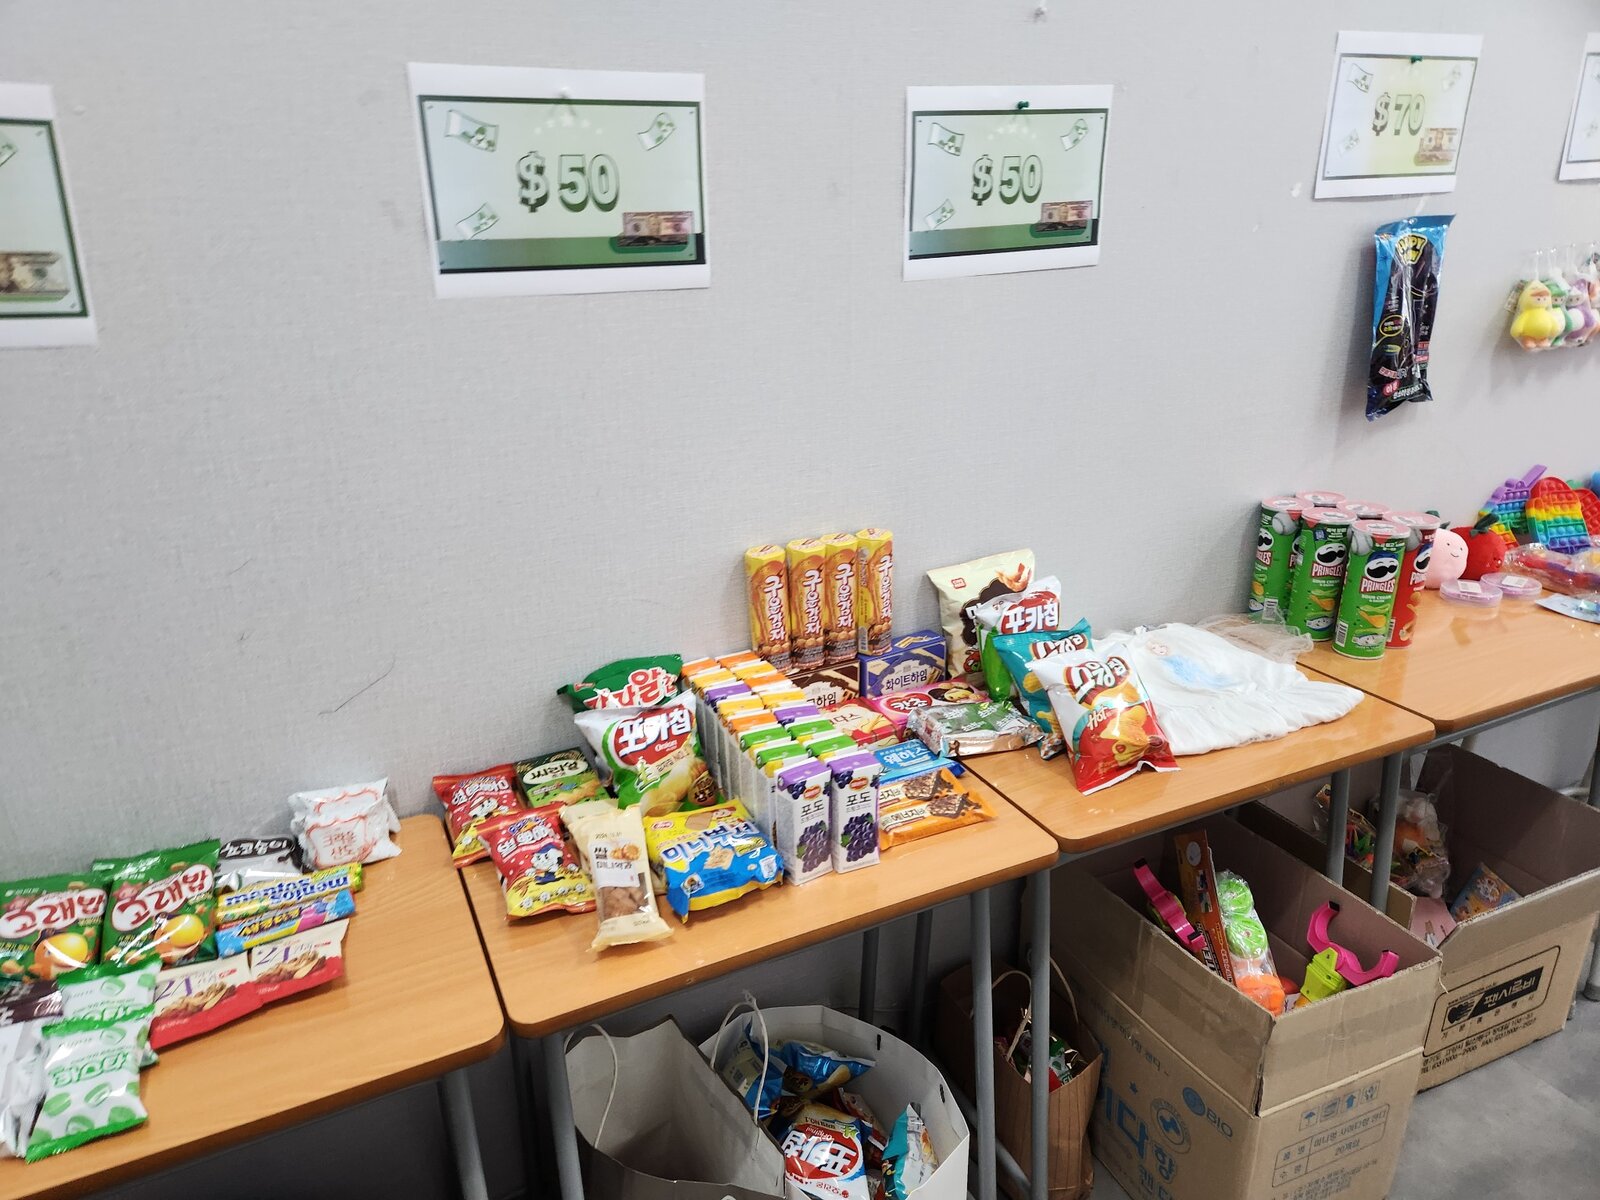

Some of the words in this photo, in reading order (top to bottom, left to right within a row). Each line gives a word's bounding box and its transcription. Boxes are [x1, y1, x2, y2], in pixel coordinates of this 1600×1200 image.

[1372, 91, 1425, 137] $70
[515, 150, 620, 213] $50
[971, 153, 1043, 206] $50
[878, 555, 893, 619] 구운감자
[1311, 563, 1343, 577] PRINGLES
[1361, 578, 1396, 593] PRINGLES
[764, 575, 785, 641] 구운감자
[802, 569, 823, 634] 구운감자
[834, 563, 855, 628] 구운감자
[885, 669, 928, 691] 화이트하임
[1070, 656, 1127, 704] 스윙칩
[618, 708, 692, 758] 포카칩
[1087, 707, 1110, 730] Hot
[884, 748, 931, 765] 웨하스
[801, 800, 824, 818] 포도
[846, 791, 872, 807] 포도
[118, 869, 208, 926] 고래밥
[226, 878, 311, 908] mentos
[270, 875, 350, 905] mentos
[6, 894, 106, 934] 고래밥
[1206, 1109, 1234, 1138] BIO
[781, 1130, 857, 1177] 포카칩
